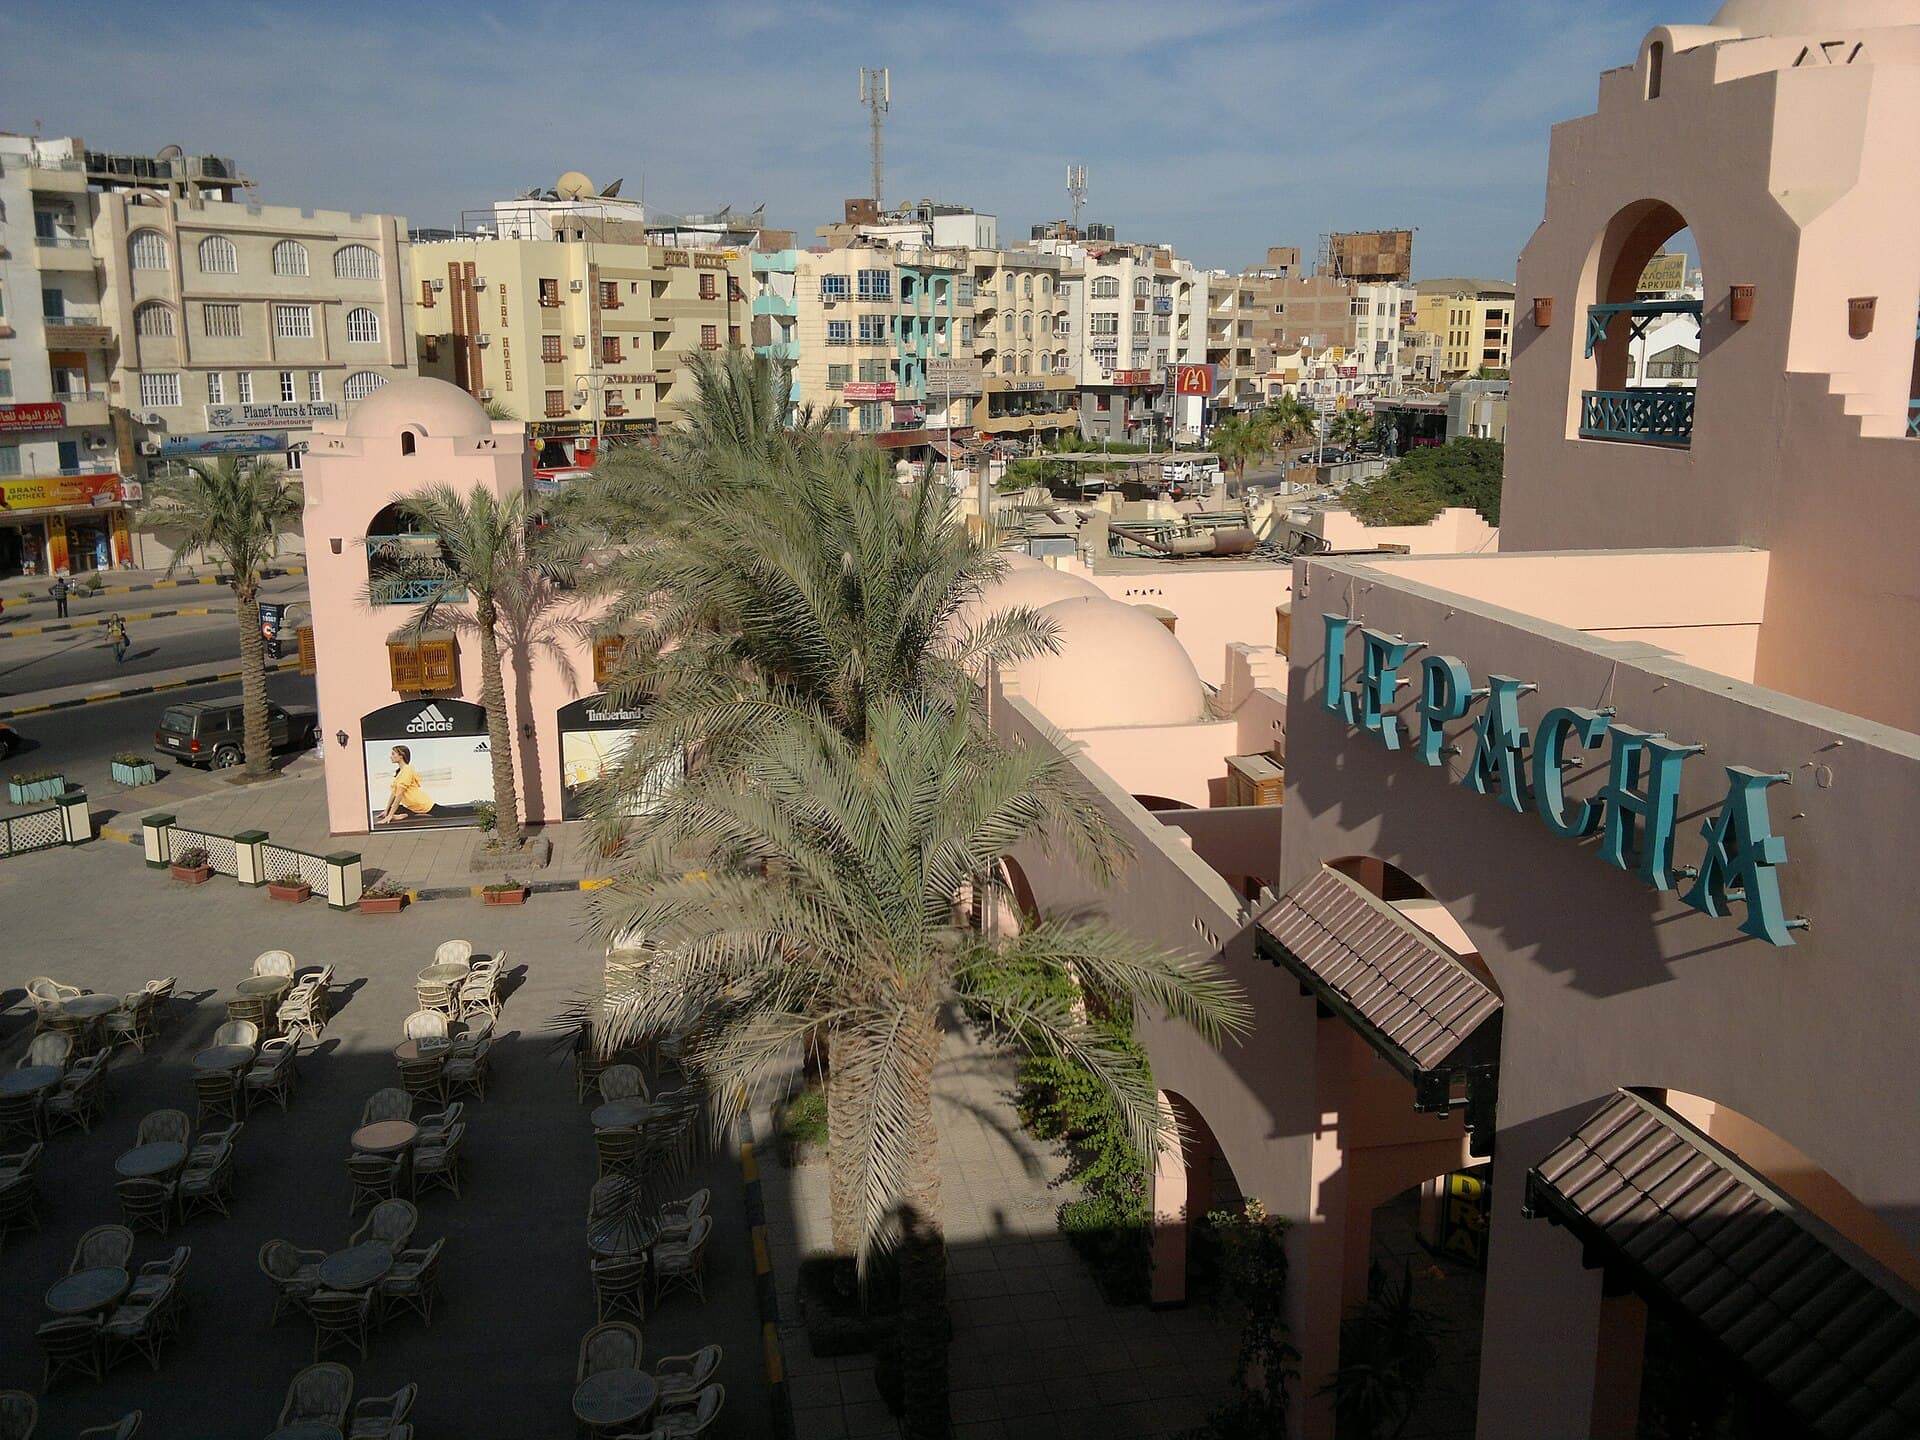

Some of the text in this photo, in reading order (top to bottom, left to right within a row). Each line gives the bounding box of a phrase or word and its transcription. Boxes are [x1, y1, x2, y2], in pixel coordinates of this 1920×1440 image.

[1642, 271, 1681, 280] ХЛОПКА
[499, 283, 513, 391] BIBA HOTEL
[243, 403, 333, 419] Planet Tours & Travel
[531, 423, 540, 437] 7
[599, 421, 606, 436] 7
[7, 492, 46, 501] APOTHEKE
[9, 486, 44, 495] GRAND
[585, 708, 642, 722] Timberland
[406, 720, 453, 733] adidas
[1413, 655, 1796, 947] PACHA
